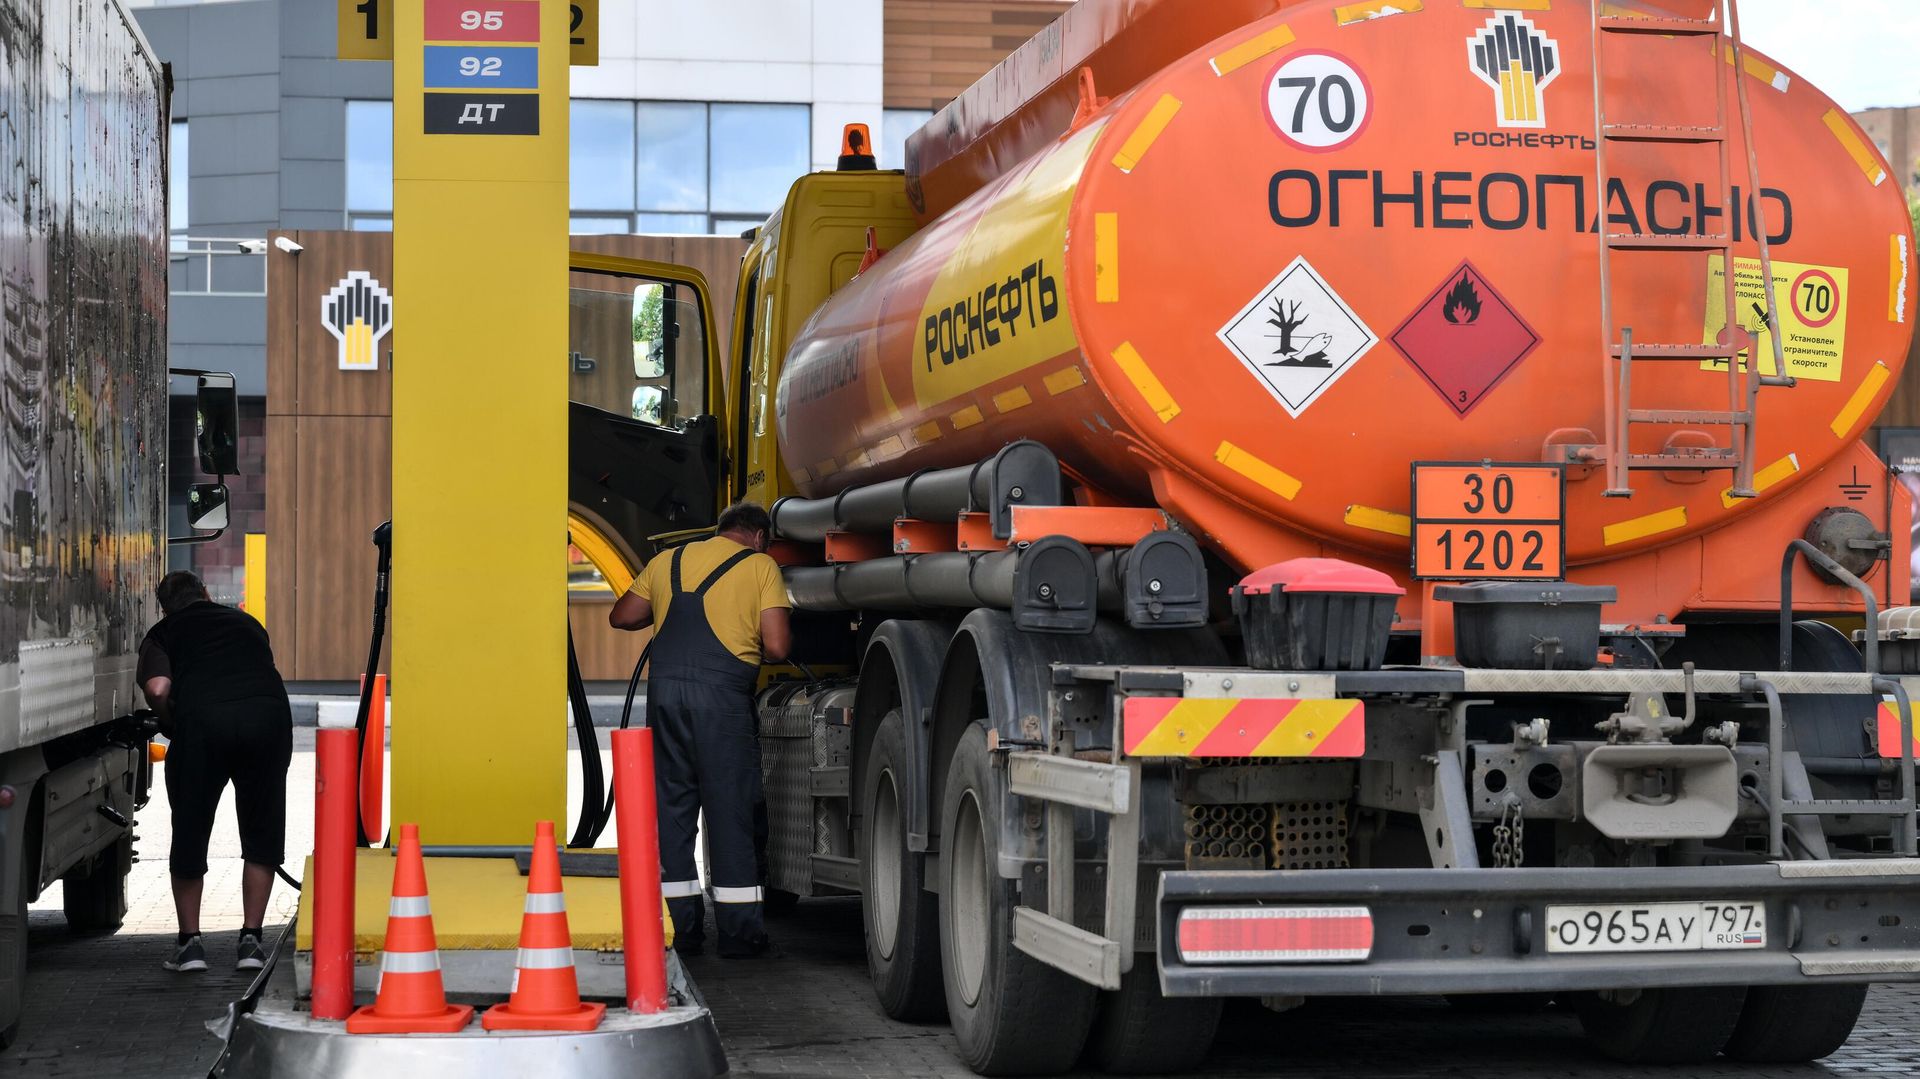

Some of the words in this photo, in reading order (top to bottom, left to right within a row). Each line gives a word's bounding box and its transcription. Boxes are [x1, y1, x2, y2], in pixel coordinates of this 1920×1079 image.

[357, 0, 378, 39] 1
[460, 10, 503, 31] 95
[459, 56, 503, 76] 92
[458, 103, 505, 124] ДТ
[1278, 74, 1355, 133] 70
[1454, 131, 1596, 150] РОСНЕФТЬ
[1268, 169, 1793, 245] ОГНЕОПАСНО
[1713, 270, 1754, 279] Автобиль
[1735, 291, 1765, 299] ГЛОНАСС
[1803, 283, 1830, 314] 70
[925, 258, 1058, 373] РОСНЕФТЬ
[1790, 333, 1835, 345] Установлен
[1783, 346, 1838, 357] ограничитель
[1792, 359, 1828, 368] скорости
[1459, 390, 1467, 402] 3
[1463, 473, 1514, 514] 30
[1436, 529, 1544, 571] 1202
[1559, 910, 1695, 946] О965АУ
[1704, 905, 1755, 932] 797
[1716, 933, 1742, 944] RUS
